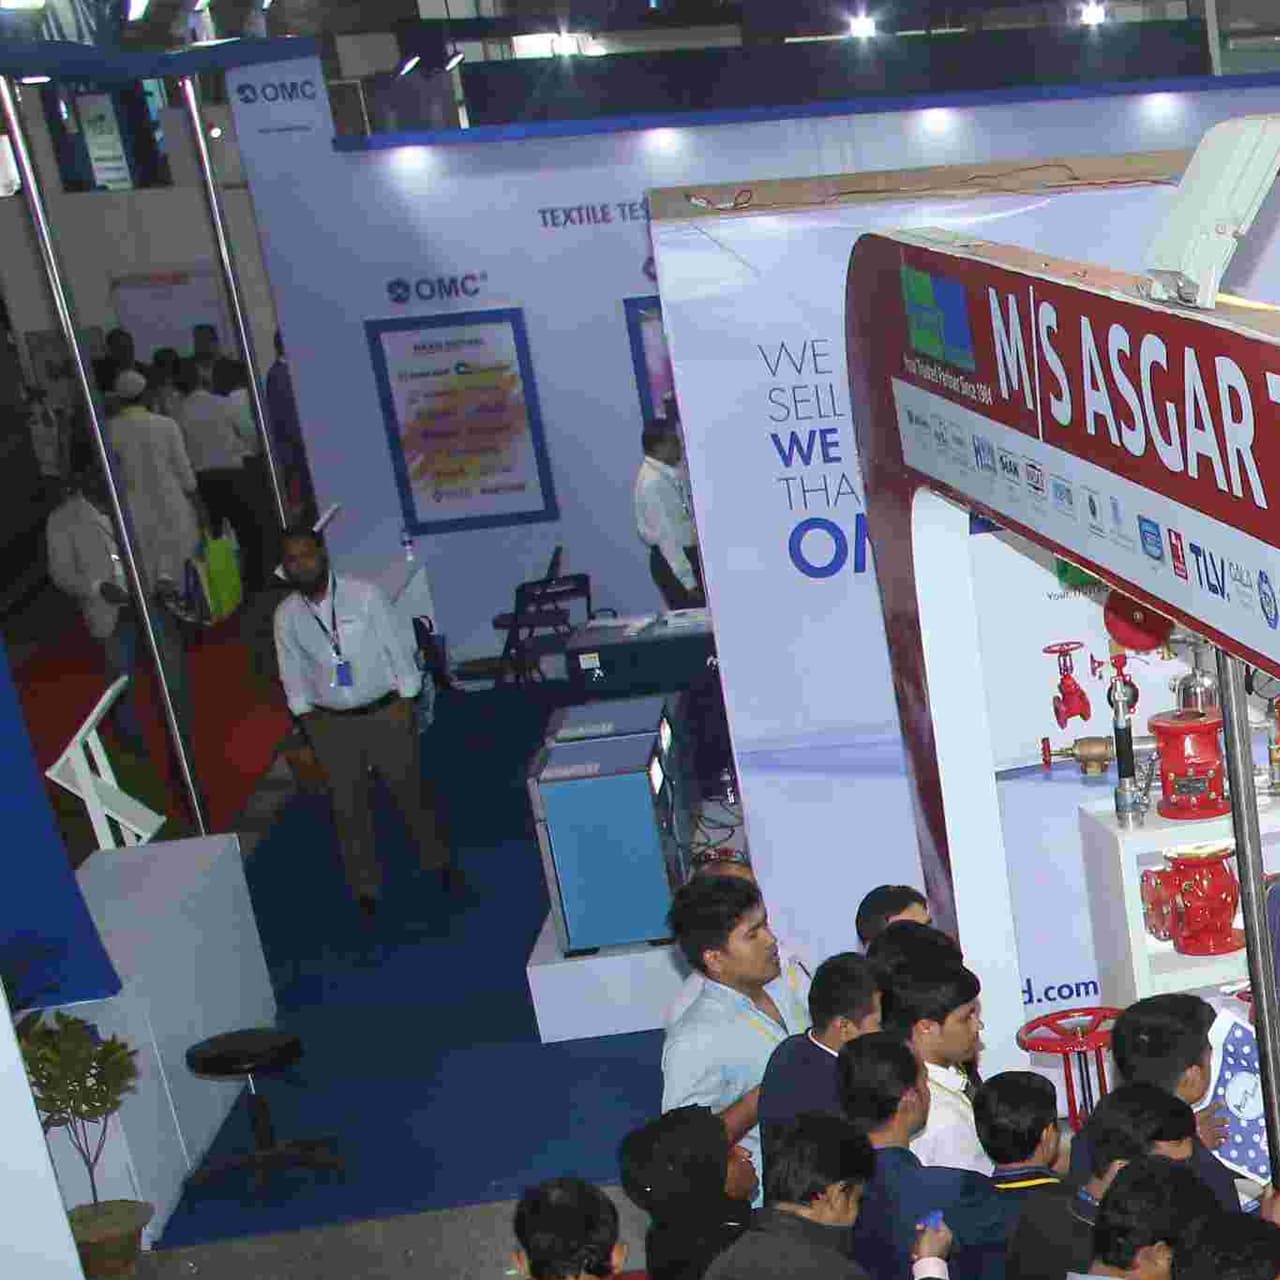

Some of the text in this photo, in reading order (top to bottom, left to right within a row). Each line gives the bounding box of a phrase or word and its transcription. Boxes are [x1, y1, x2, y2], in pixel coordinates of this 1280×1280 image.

[261, 80, 316, 102] OMC
[538, 202, 613, 228] TEXTILE
[415, 274, 480, 301] OMC
[758, 339, 832, 376] WE
[768, 383, 845, 422] SELL
[987, 285, 1073, 441] M/S
[1080, 315, 1269, 509] ASGAR
[771, 428, 841, 467] WE
[1189, 542, 1227, 599] TLV
